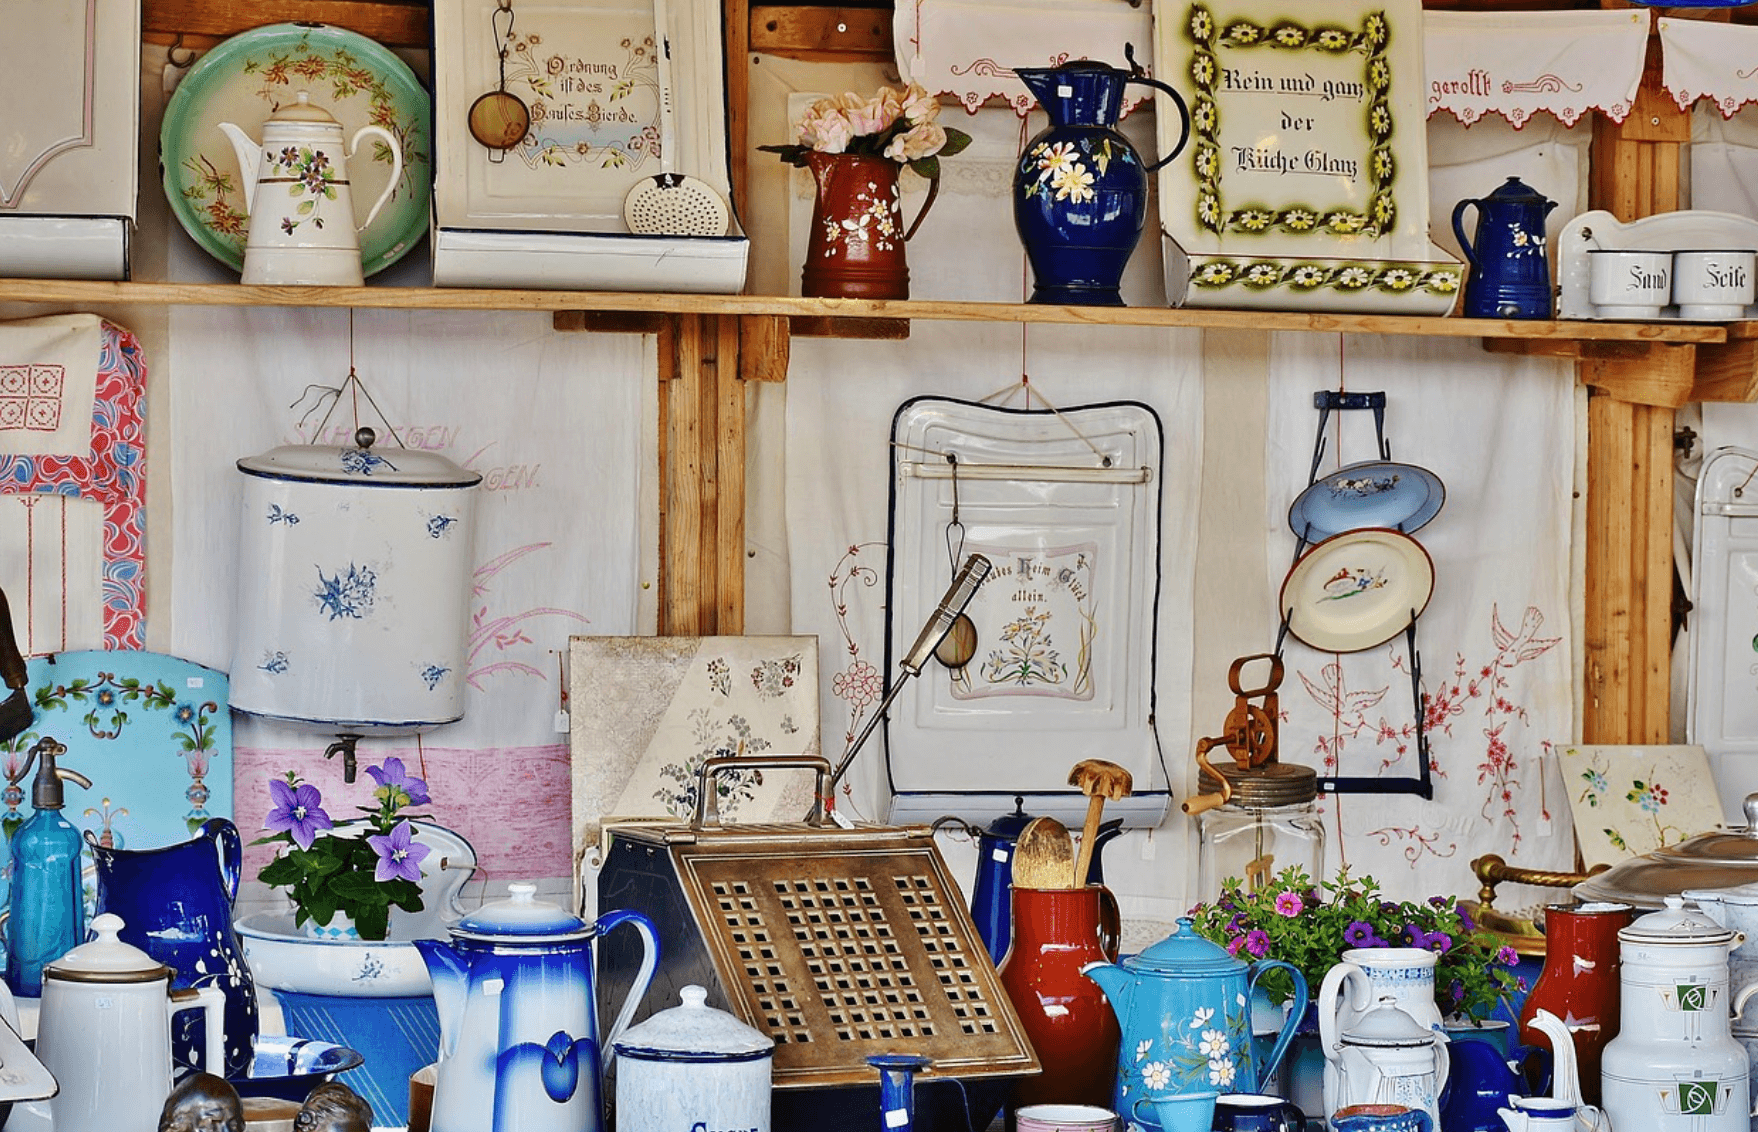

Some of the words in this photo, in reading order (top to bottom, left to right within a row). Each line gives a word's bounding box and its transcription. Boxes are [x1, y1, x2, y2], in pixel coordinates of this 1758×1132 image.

[546, 55, 618, 80] Ordnung
[576, 77, 603, 94] des
[1221, 68, 1274, 91] Rein
[1279, 73, 1315, 92] und
[1320, 79, 1364, 103] ganz
[1428, 68, 1491, 103] gerollt
[1280, 110, 1315, 131] der
[1231, 146, 1299, 176] Küche
[1304, 149, 1358, 183] Glanz
[1626, 264, 1667, 292] Sand
[1702, 262, 1746, 291] Seife
[484, 463, 541, 492] GEN.
[1011, 588, 1048, 603] allein.
